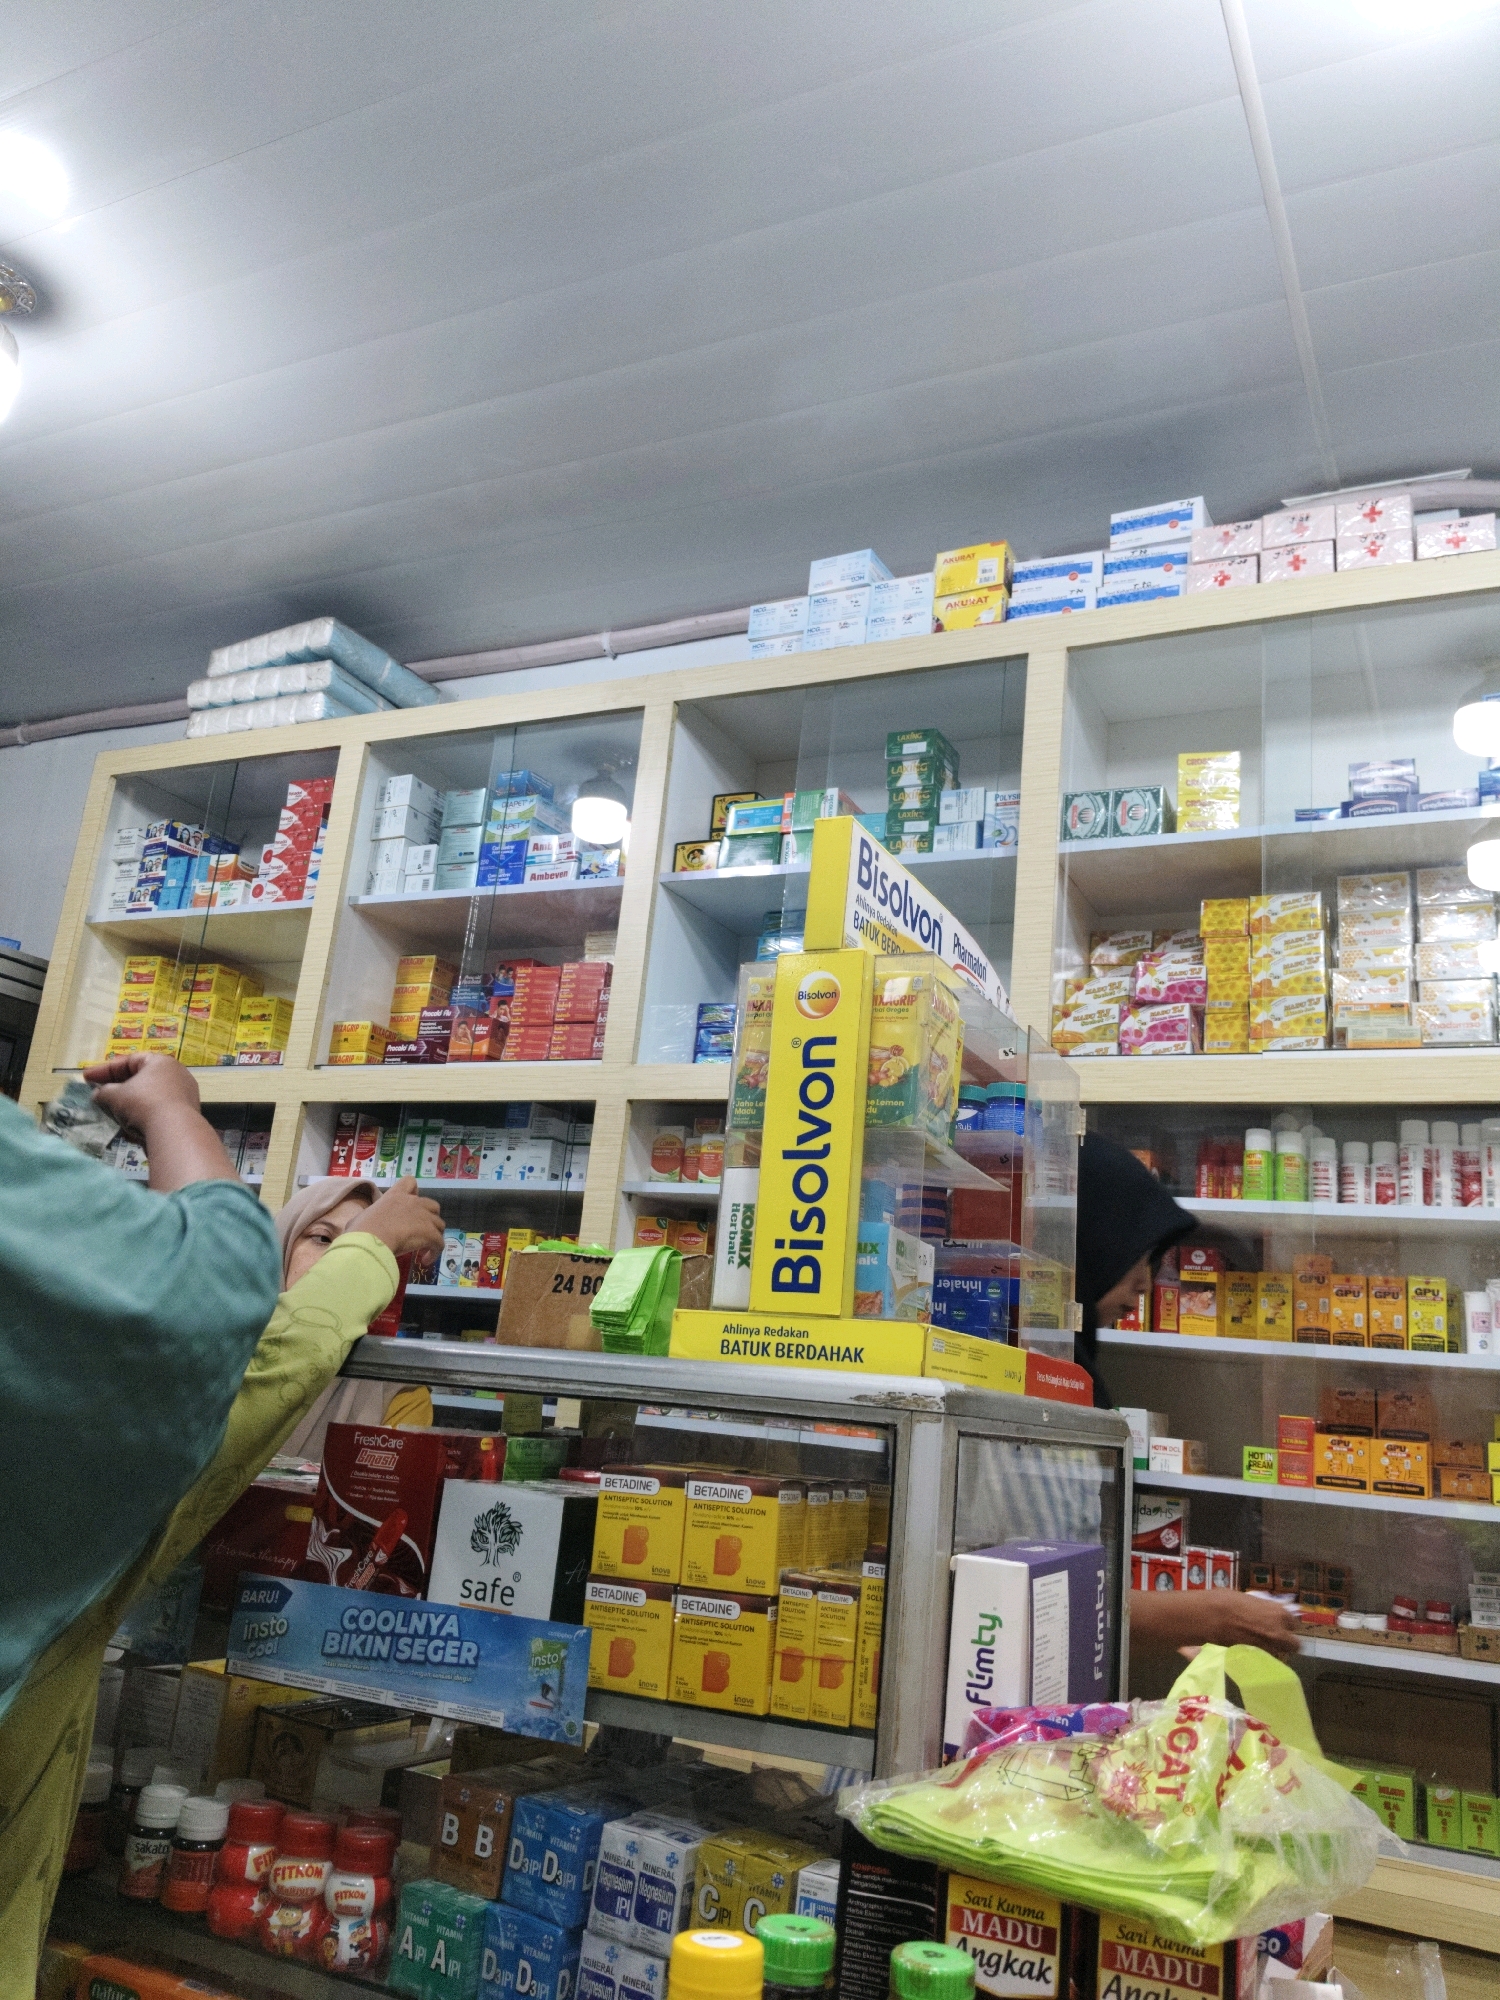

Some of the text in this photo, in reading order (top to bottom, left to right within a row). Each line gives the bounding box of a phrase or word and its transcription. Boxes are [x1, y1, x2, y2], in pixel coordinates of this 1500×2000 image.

[943, 552, 976, 565] AKURAT
[875, 583, 889, 591] HCG
[814, 597, 828, 605] HCG
[945, 595, 990, 610] AKURAT
[753, 606, 767, 614] HCG
[871, 616, 885, 624] HCG
[807, 627, 821, 635] HCG
[752, 642, 765, 650] HCG
[502, 800, 526, 809] DIAPET
[497, 822, 520, 831] DIAPET
[530, 870, 569, 882] Ambeven
[857, 836, 942, 955] Bisolvon
[853, 910, 880, 947] BATUK
[394, 986, 420, 995] MIXAGRIP
[798, 989, 837, 1000] Bisolvon
[389, 1014, 416, 1023] MIXAGRIP
[334, 1023, 360, 1033] MIXAGRIP
[386, 1043, 418, 1052] Procold Flu
[239, 1053, 261, 1065] BEJO
[329, 1055, 355, 1064] MIXAGRIP
[734, 1107, 756, 1115] Madu
[735, 1099, 754, 1108] Jahe
[771, 1036, 837, 1294] Bisolvon
[737, 1203, 756, 1270] KOMIX
[552, 1273, 575, 1294] 24
[937, 1278, 981, 1293] Inhaler
[1335, 1289, 1361, 1299] GPU
[1374, 1291, 1400, 1301] GPU
[1414, 1287, 1441, 1298] GPU
[722, 1323, 809, 1338] Ahlinya Redakan
[720, 1338, 864, 1363] BATUK BERDAHAK
[353, 1431, 404, 1449] FreshCare
[1330, 1438, 1351, 1448] GPU
[1386, 1443, 1407, 1453] GPU
[1249, 1460, 1273, 1469] CREAM
[604, 1477, 653, 1492] BETADINE
[693, 1484, 746, 1501] BETADINE
[604, 1494, 673, 1507] ANTISEPTIC SOLUTION
[693, 1502, 767, 1517] ANTISEPTIC SOLUTION
[651, 1565, 670, 1575] inova
[745, 1576, 766, 1586] inova
[241, 1589, 279, 1604] BARU!
[460, 1576, 515, 1607] safe
[590, 1586, 640, 1604] BETADINE
[782, 1586, 811, 1598] BETADINE
[821, 1593, 851, 1604] BETADINE
[590, 1604, 660, 1620] ANTISEPTIC SOLUTION
[681, 1598, 733, 1616] BETADINE
[781, 1605, 806, 1615] SOLUTION
[782, 1599, 810, 1609] ANTISEPTIC
[820, 1605, 849, 1616] ANTISEPTIC
[341, 1607, 460, 1638] COOLNYA
[820, 1612, 846, 1621] SOLUTION
[243, 1614, 288, 1640] insto
[680, 1617, 755, 1634] ANTISEPTIC SOLUTION
[323, 1630, 480, 1666] BIKIN SEGER
[531, 1652, 559, 1669] insto
[965, 1611, 1003, 1706] Flimty
[638, 1679, 659, 1689] inova
[734, 1694, 755, 1705] inova
[441, 1812, 459, 1846] B
[517, 1823, 543, 1842] VITAMIN
[474, 1824, 494, 1858] B
[550, 1836, 578, 1854] VITAMIN
[603, 1851, 636, 1870] MINERAL
[273, 1864, 323, 1883] FITKOM
[642, 1861, 676, 1881] MINERAL
[599, 1866, 633, 1895] Magnesium
[334, 1890, 367, 1902] FITKOM
[638, 1876, 674, 1906] Magnesium
[748, 1882, 782, 1902] VITAMIN
[615, 1896, 631, 1918] IPI
[698, 1883, 732, 1927] C IPI
[963, 1889, 1045, 1921] Sari Kurma
[404, 1910, 430, 1928] VITAMIN
[656, 1908, 672, 1930] IPI
[436, 1924, 463, 1942] VITAMIN
[961, 1908, 1044, 1949] MADU
[1116, 1924, 1148, 1944] Sari
[398, 1925, 427, 1963] A IPI
[489, 1934, 515, 1952] VITAMIN
[430, 1939, 461, 1978] A IPI
[523, 1944, 551, 1963] VITAMIN
[955, 1936, 1052, 1985] Angkak
[583, 1956, 615, 1976] MINERAL
[1115, 1946, 1205, 1988] MADU
[622, 1974, 655, 1995] MINERAL
